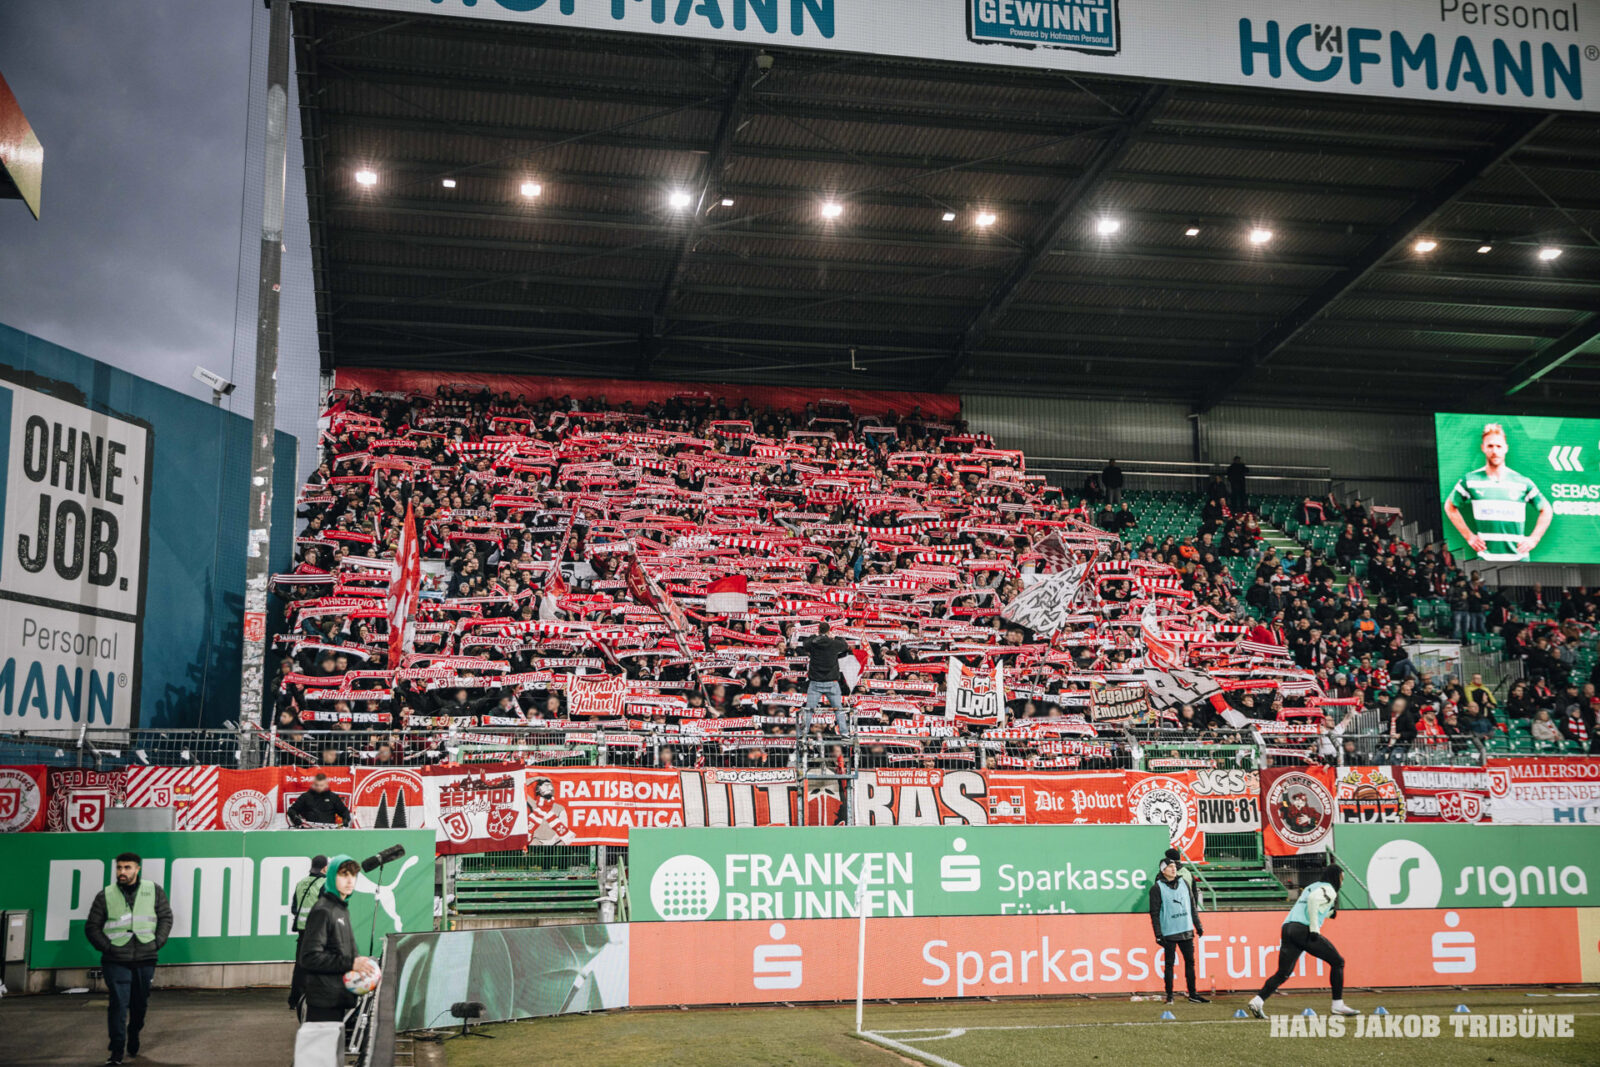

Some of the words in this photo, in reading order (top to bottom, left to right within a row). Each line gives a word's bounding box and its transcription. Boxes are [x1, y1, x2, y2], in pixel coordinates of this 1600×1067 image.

[978, 0, 1108, 33] GEWINNT
[1440, 0, 1579, 32] Personal
[1010, 28, 1039, 38] Powered
[1040, 31, 1049, 40] by
[1081, 34, 1110, 44] Personal
[23, 414, 127, 505] OHNE
[17, 493, 129, 592] JOB.
[22, 617, 118, 661] Personal
[1090, 687, 1146, 707] Legalize
[1092, 699, 1148, 719] Emotions
[52, 771, 83, 788] RED
[86, 771, 128, 787] BOYS
[560, 780, 681, 800] RATISBONA
[1033, 790, 1065, 811] Die
[1070, 789, 1124, 814] Power
[572, 808, 683, 828] FANATICA
[725, 852, 913, 887] FRANKEN
[998, 862, 1148, 898] Sparkasse
[1455, 865, 1588, 907] signia
[922, 936, 1178, 997] Sparkasse
